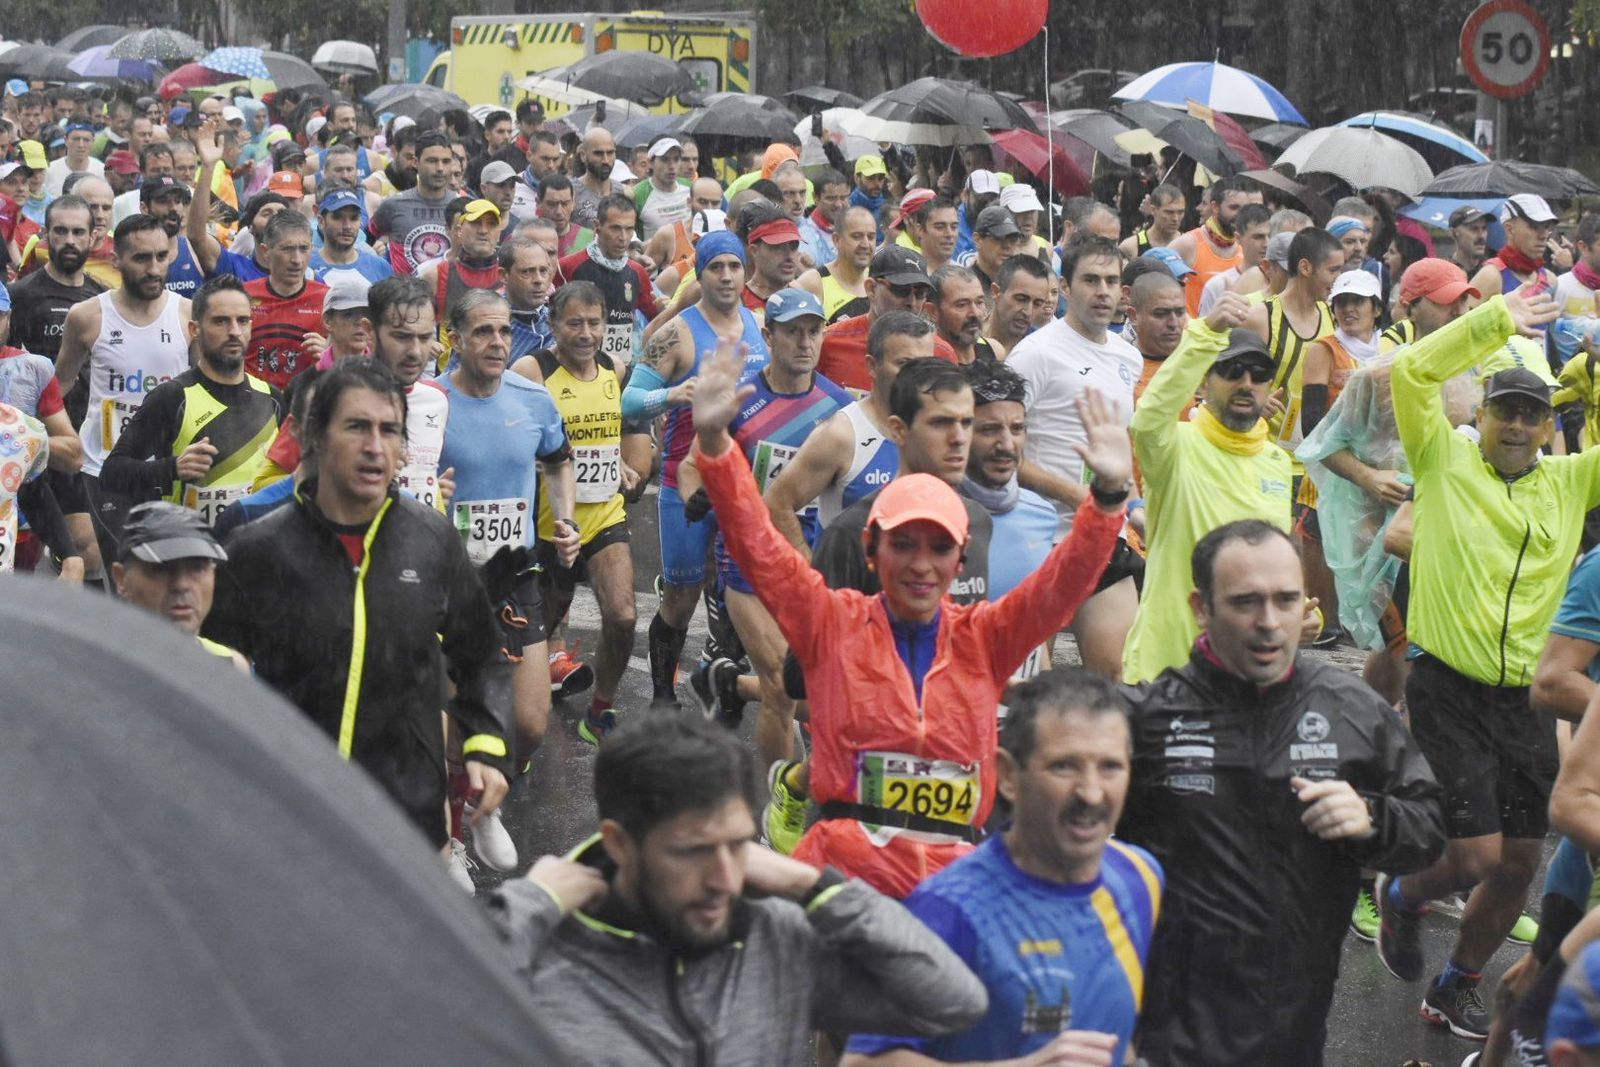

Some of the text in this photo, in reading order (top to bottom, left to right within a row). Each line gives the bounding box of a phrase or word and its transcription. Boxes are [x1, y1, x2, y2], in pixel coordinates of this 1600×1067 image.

[648, 33, 695, 55] DYA
[1482, 32, 1532, 65] 50
[576, 460, 618, 483] 2276
[473, 516, 522, 542] 3504
[887, 781, 973, 816] 2694
